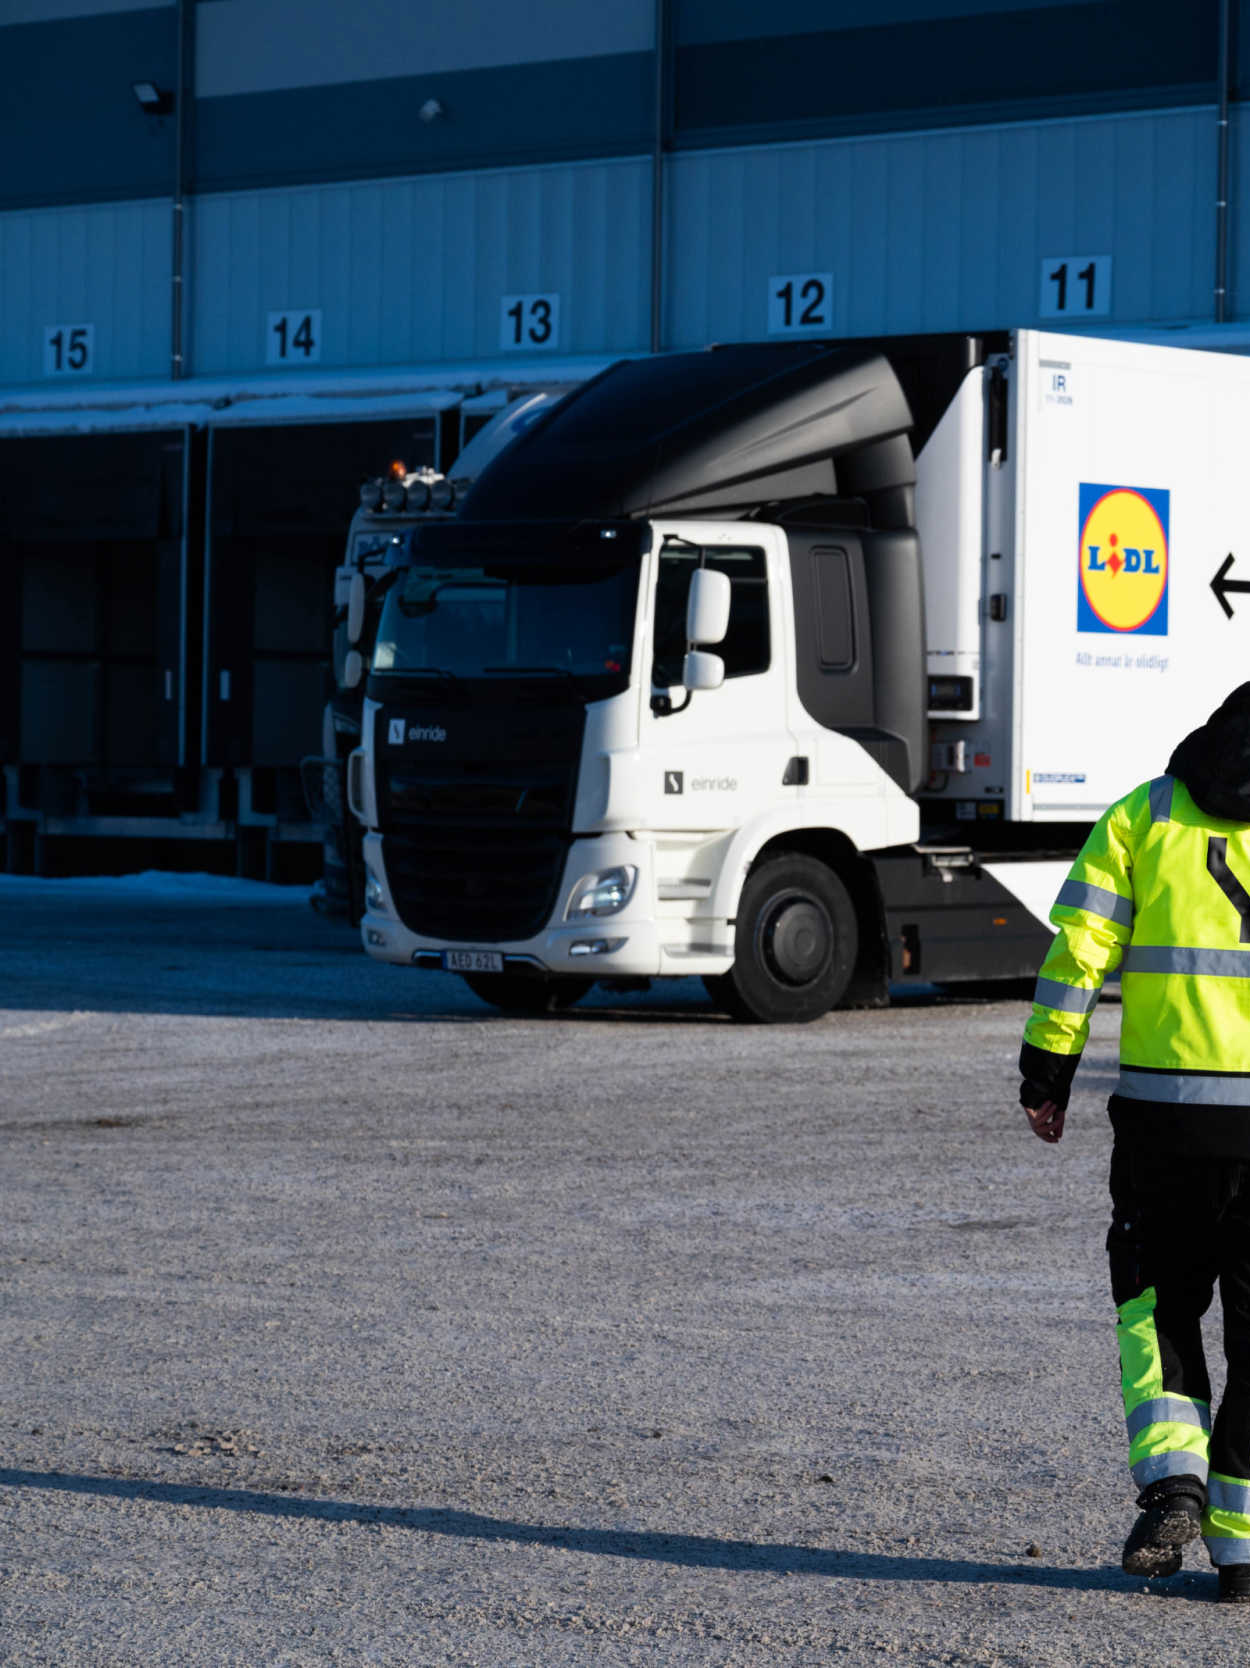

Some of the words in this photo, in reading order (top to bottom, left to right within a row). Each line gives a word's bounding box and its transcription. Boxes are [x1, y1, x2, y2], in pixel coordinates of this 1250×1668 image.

[776, 278, 825, 327] 12
[1049, 262, 1096, 311] 11
[273, 315, 315, 358] 14
[507, 299, 552, 345] 13
[50, 329, 88, 371] 15
[409, 724, 447, 742] einride
[690, 777, 738, 792] einride
